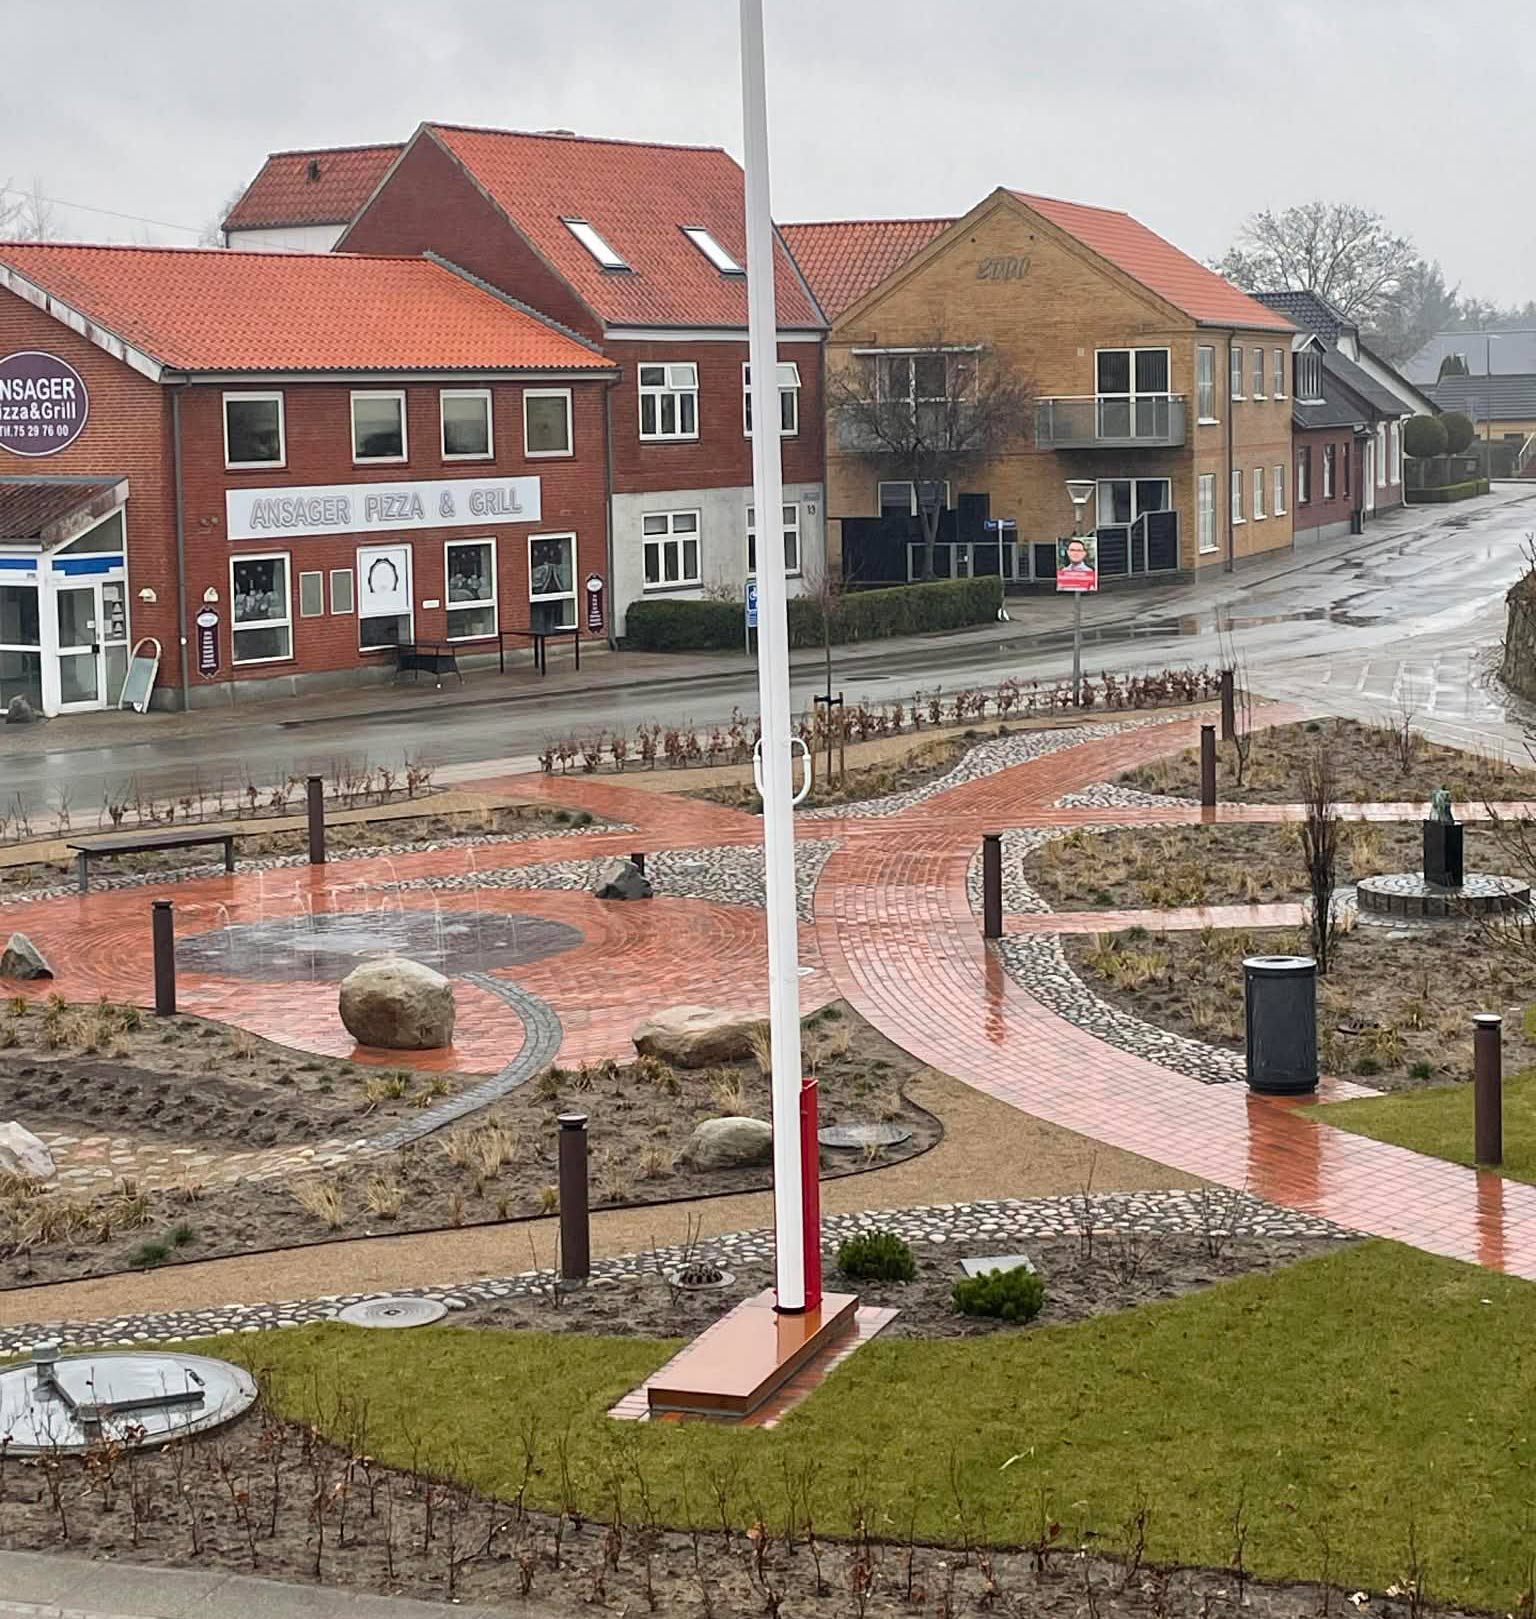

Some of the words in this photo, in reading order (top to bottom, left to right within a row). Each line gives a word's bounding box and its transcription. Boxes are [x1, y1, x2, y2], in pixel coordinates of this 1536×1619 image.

[0, 378, 76, 400] NSAGER
[0, 402, 76, 420] izza&Grill
[27, 425, 39, 437] 29
[42, 425, 54, 437] 76
[56, 425, 69, 437] 00
[250, 496, 350, 528] ANSAGER
[365, 492, 425, 521] PIZZA
[439, 489, 455, 517] &
[469, 487, 522, 516] GRILL
